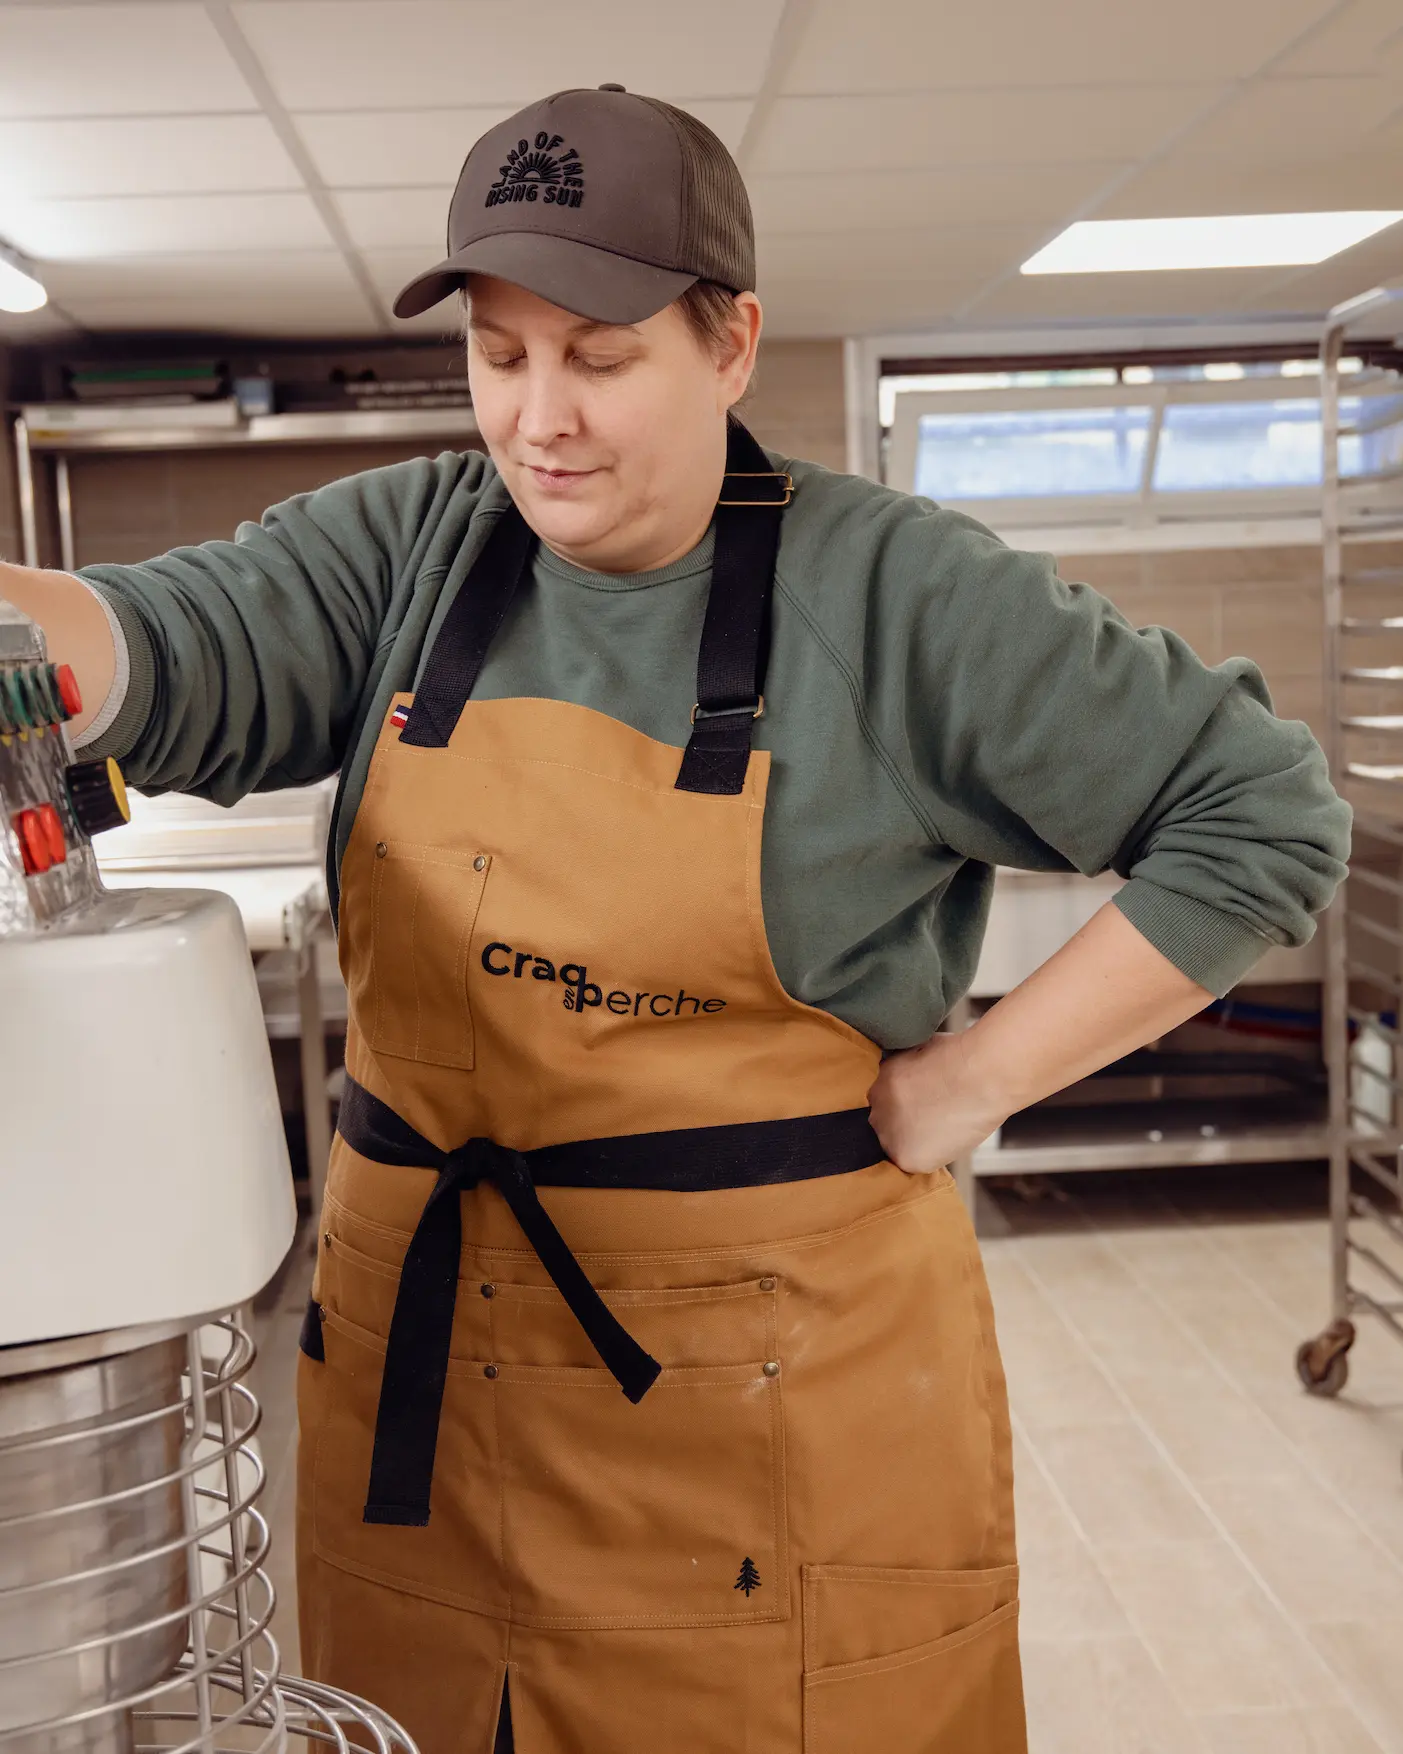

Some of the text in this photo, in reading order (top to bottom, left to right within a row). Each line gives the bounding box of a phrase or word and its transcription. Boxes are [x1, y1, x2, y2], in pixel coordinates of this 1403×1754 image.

[491, 131, 584, 188] LAND OF THE
[485, 184, 584, 207] RISING SUN
[575, 983, 727, 1016] perche
